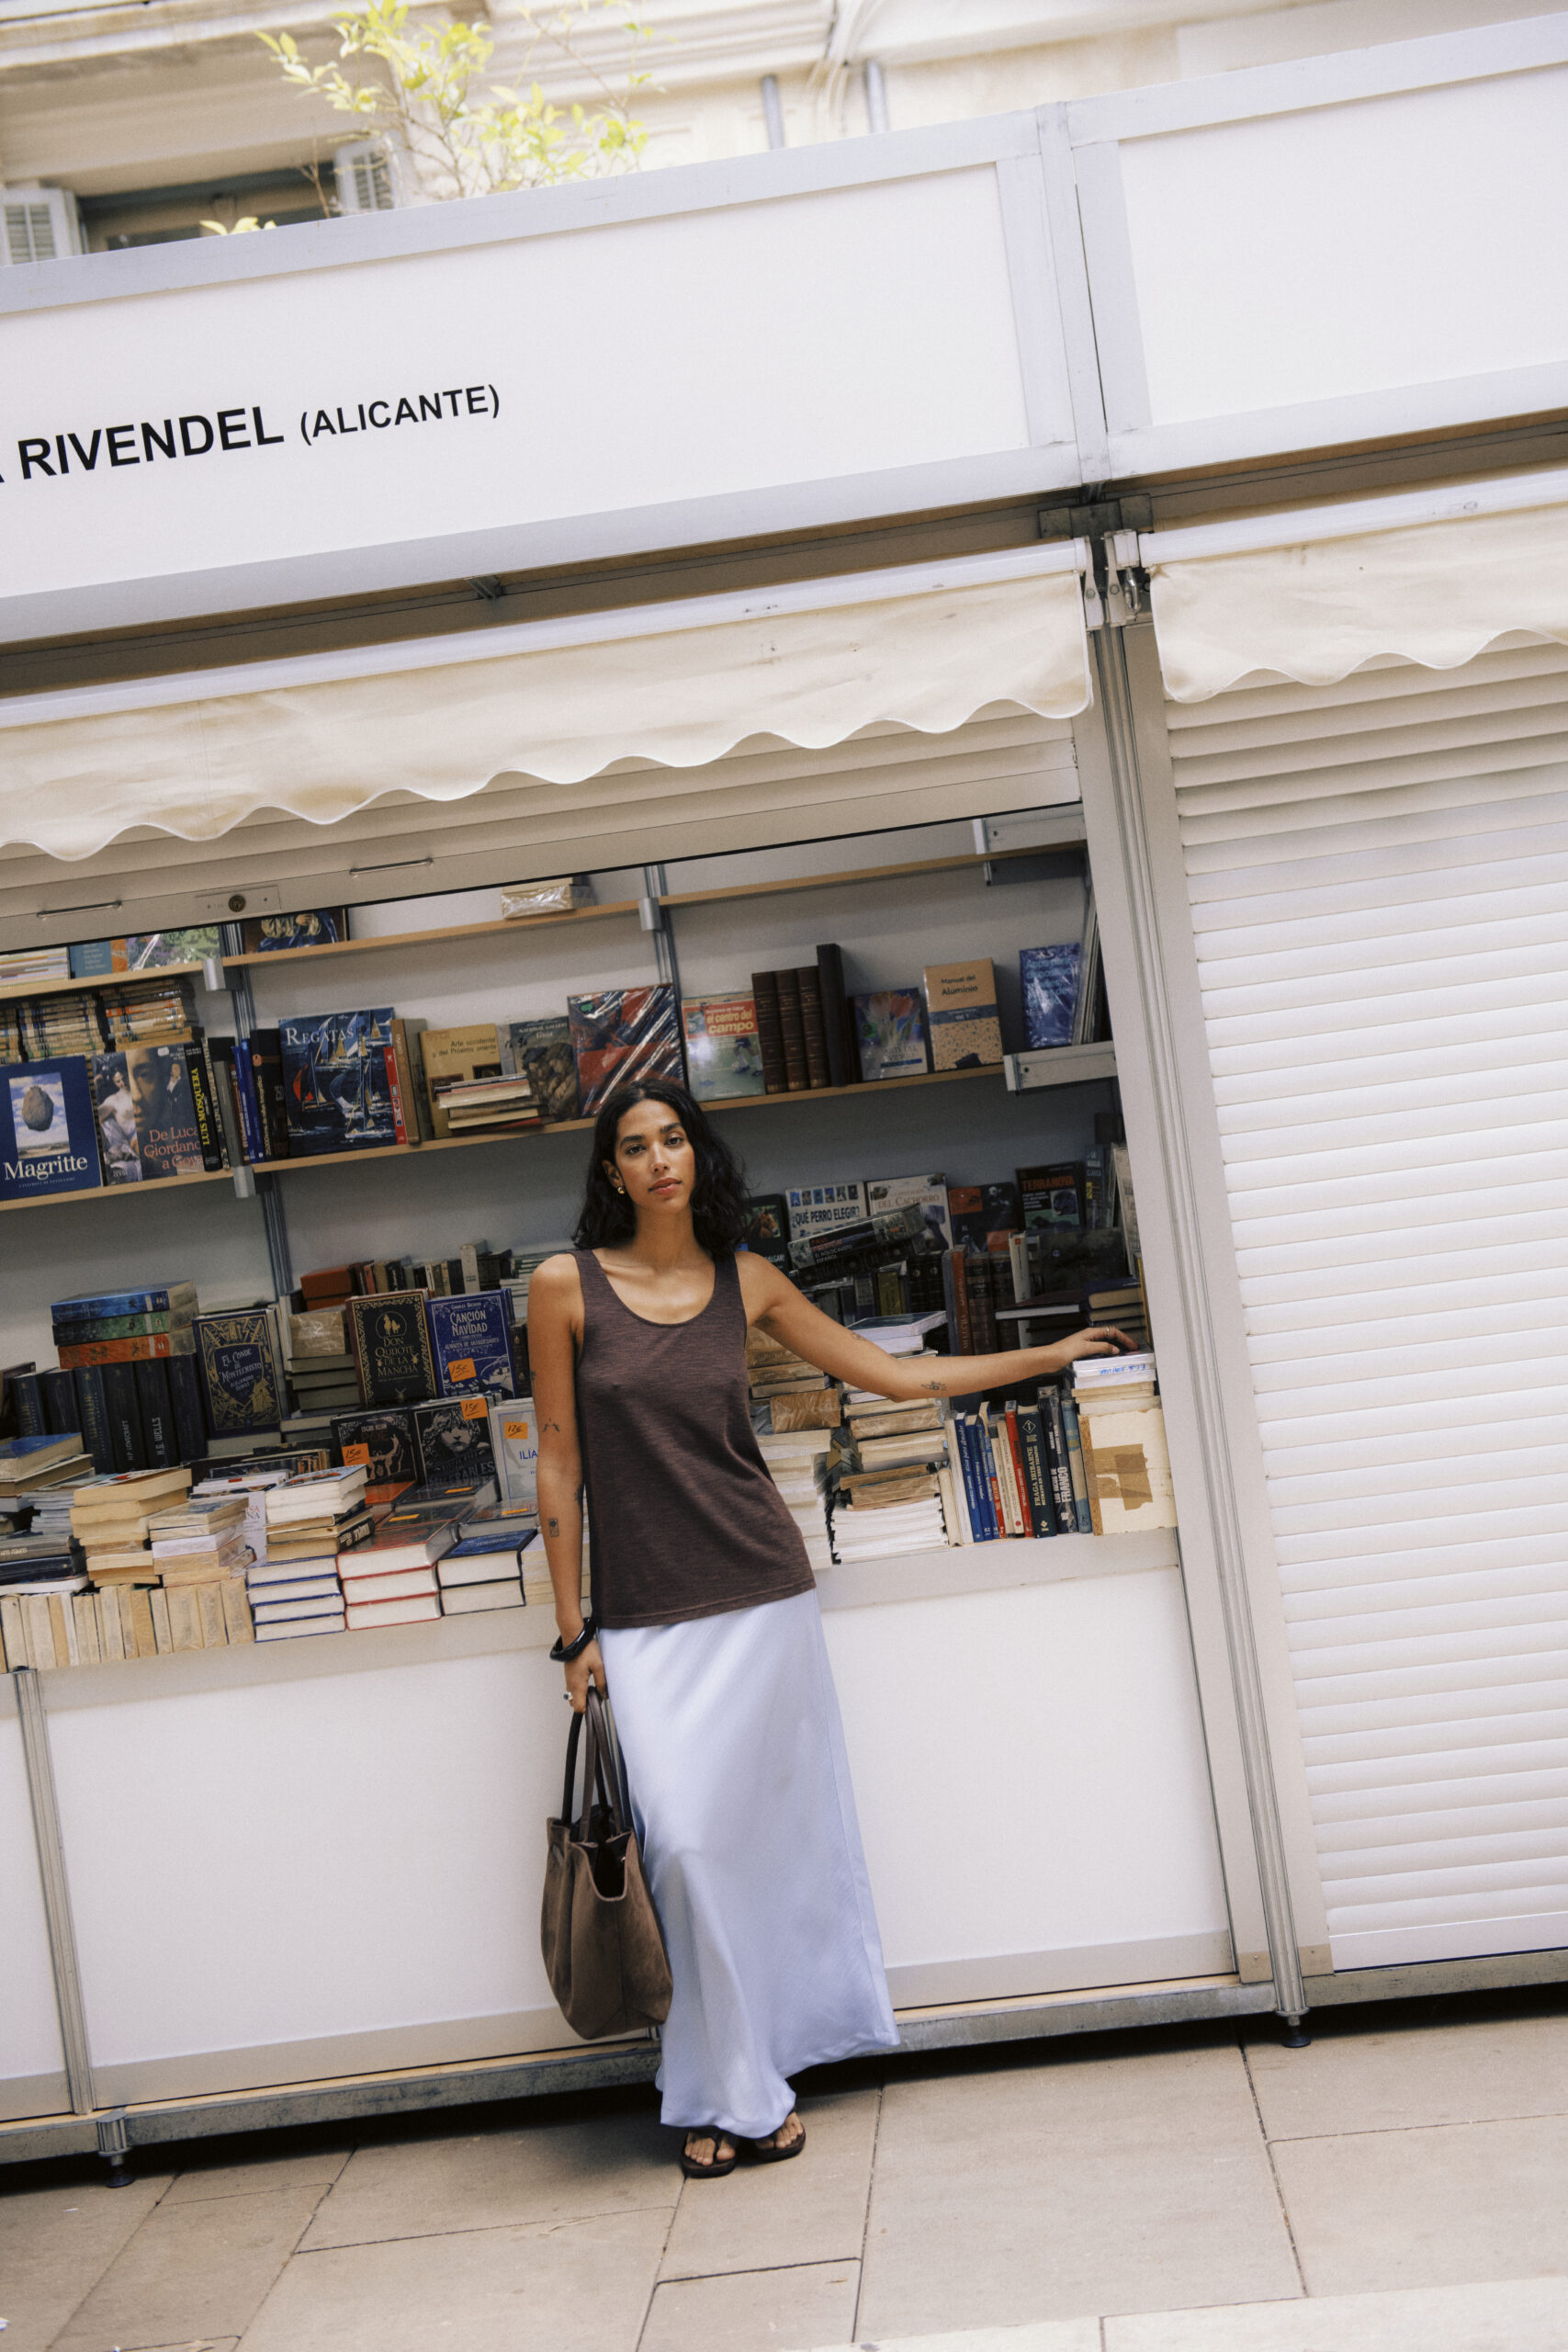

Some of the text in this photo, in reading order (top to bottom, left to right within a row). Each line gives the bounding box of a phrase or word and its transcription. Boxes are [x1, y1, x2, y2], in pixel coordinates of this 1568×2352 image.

[17, 384, 501, 480] RIVENDEL (ALICANTE)
[941, 976, 964, 984] Manual
[942, 985, 977, 995] Aluminio
[715, 1012, 739, 1023] centro
[740, 1009, 752, 1020] del
[708, 1021, 754, 1033] campo
[286, 1027, 355, 1046] REGATAS
[191, 1068, 207, 1122] MOSQUERA
[149, 1129, 168, 1143] De
[201, 1123, 210, 1146] LUIS
[3, 1156, 88, 1181] Magritte
[163, 1154, 203, 1169] a Goya
[1021, 1176, 1074, 1192] TERRANOVA
[791, 1205, 860, 1229] ¿QUÉ PERRO ELEGIR?
[820, 1244, 852, 1257] HOLOCAUSTO
[450, 1308, 487, 1326] CANCIÓN
[452, 1323, 488, 1337] NAVIDAD
[383, 1337, 404, 1347] DON
[232, 1349, 252, 1363] CONDE
[375, 1345, 414, 1359] QUIJOTE
[384, 1356, 409, 1366] DE LA
[221, 1363, 262, 1384] MONTECRISTO
[378, 1365, 419, 1377] MANCHA
[122, 1419, 132, 1447] LOVECRAFT
[152, 1418, 164, 1442] WELLS
[519, 1448, 538, 1460] ILÍA
[1026, 1447, 1036, 1480] IRIBARNE
[1056, 1466, 1072, 1503] FRANCO
[1032, 1481, 1041, 1507] FRAGA
